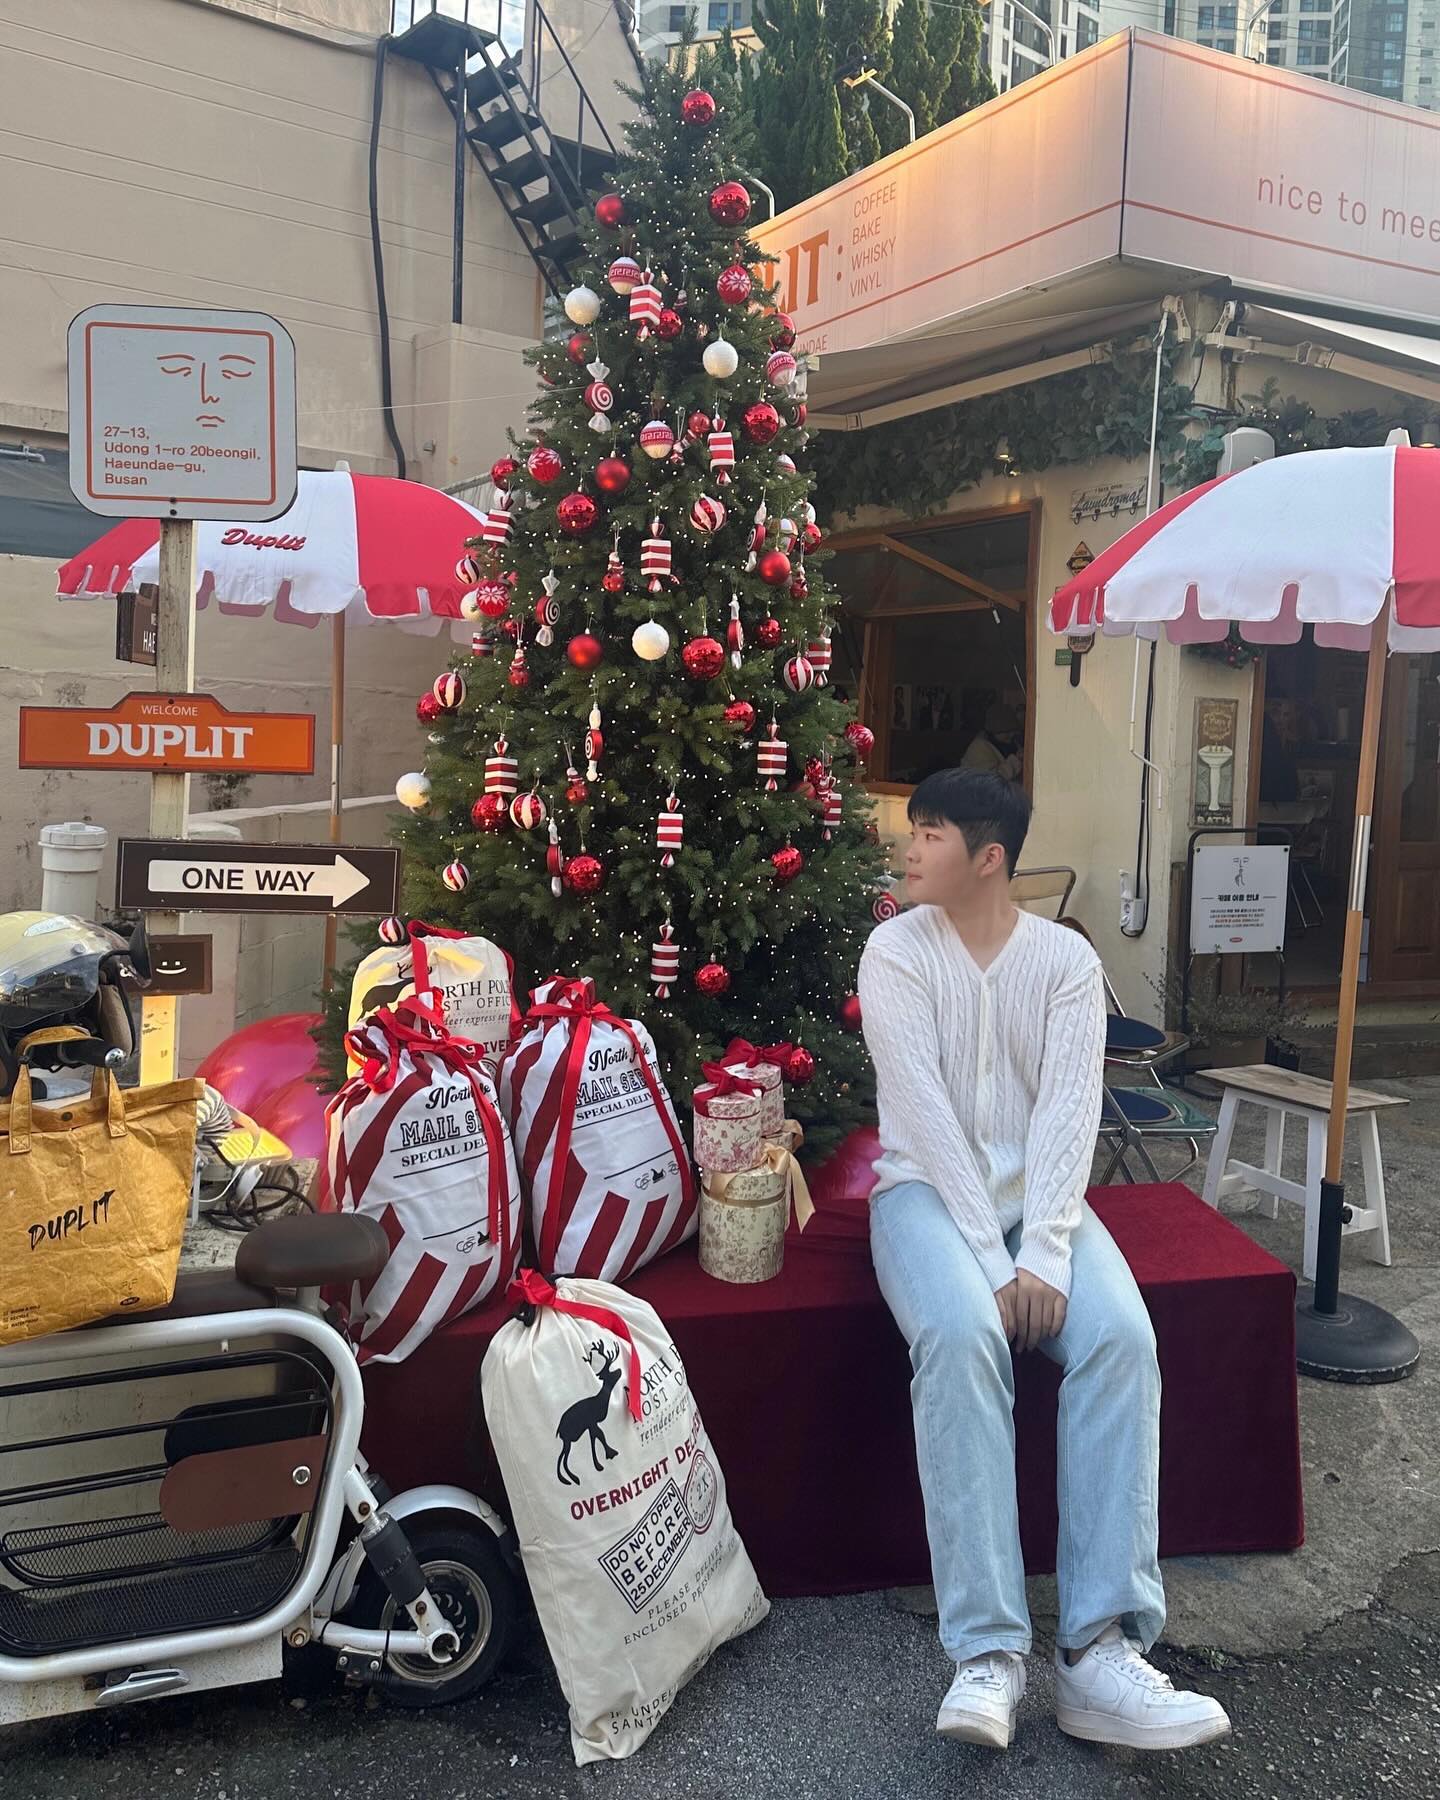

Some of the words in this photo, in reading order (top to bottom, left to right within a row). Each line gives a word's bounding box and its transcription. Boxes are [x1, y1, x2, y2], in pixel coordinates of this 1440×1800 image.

[853, 181, 898, 218] COFFEE
[1257, 174, 1323, 215] nice
[1338, 192, 1367, 225] to
[852, 216, 881, 245] BAKE
[851, 236, 897, 271] WHISKY
[850, 271, 882, 297] VINYL
[104, 442, 150, 456] Udong
[155, 444, 185, 456] 1-ro
[190, 445, 261, 460] 20beongil,
[104, 458, 206, 473] Haeundae-gu,
[104, 473, 148, 485] Busan
[221, 528, 307, 551] Duplit
[141, 705, 199, 717] WELCOME
[86, 722, 254, 759] DUPLIT
[181, 867, 244, 891] ONE
[255, 870, 315, 892] WAY
[588, 1047, 628, 1072] North
[575, 1076, 621, 1106] MAIL
[576, 1102, 626, 1122] SPECIAL
[400, 1114, 461, 1147] MAIL
[401, 1144, 461, 1167] SPECIAL
[28, 1189, 115, 1250] DUPLIT
[570, 1458, 670, 1521] OVERNIGHT
[609, 1550, 629, 1571] DO
[629, 1522, 651, 1554] NOT
[650, 1487, 677, 1526] OPEN
[621, 1502, 684, 1586] BEFORE
[647, 1582, 691, 1619] PLEASE
[624, 1601, 688, 1646] ENCLOSED
[611, 1709, 661, 1735] SANTA
